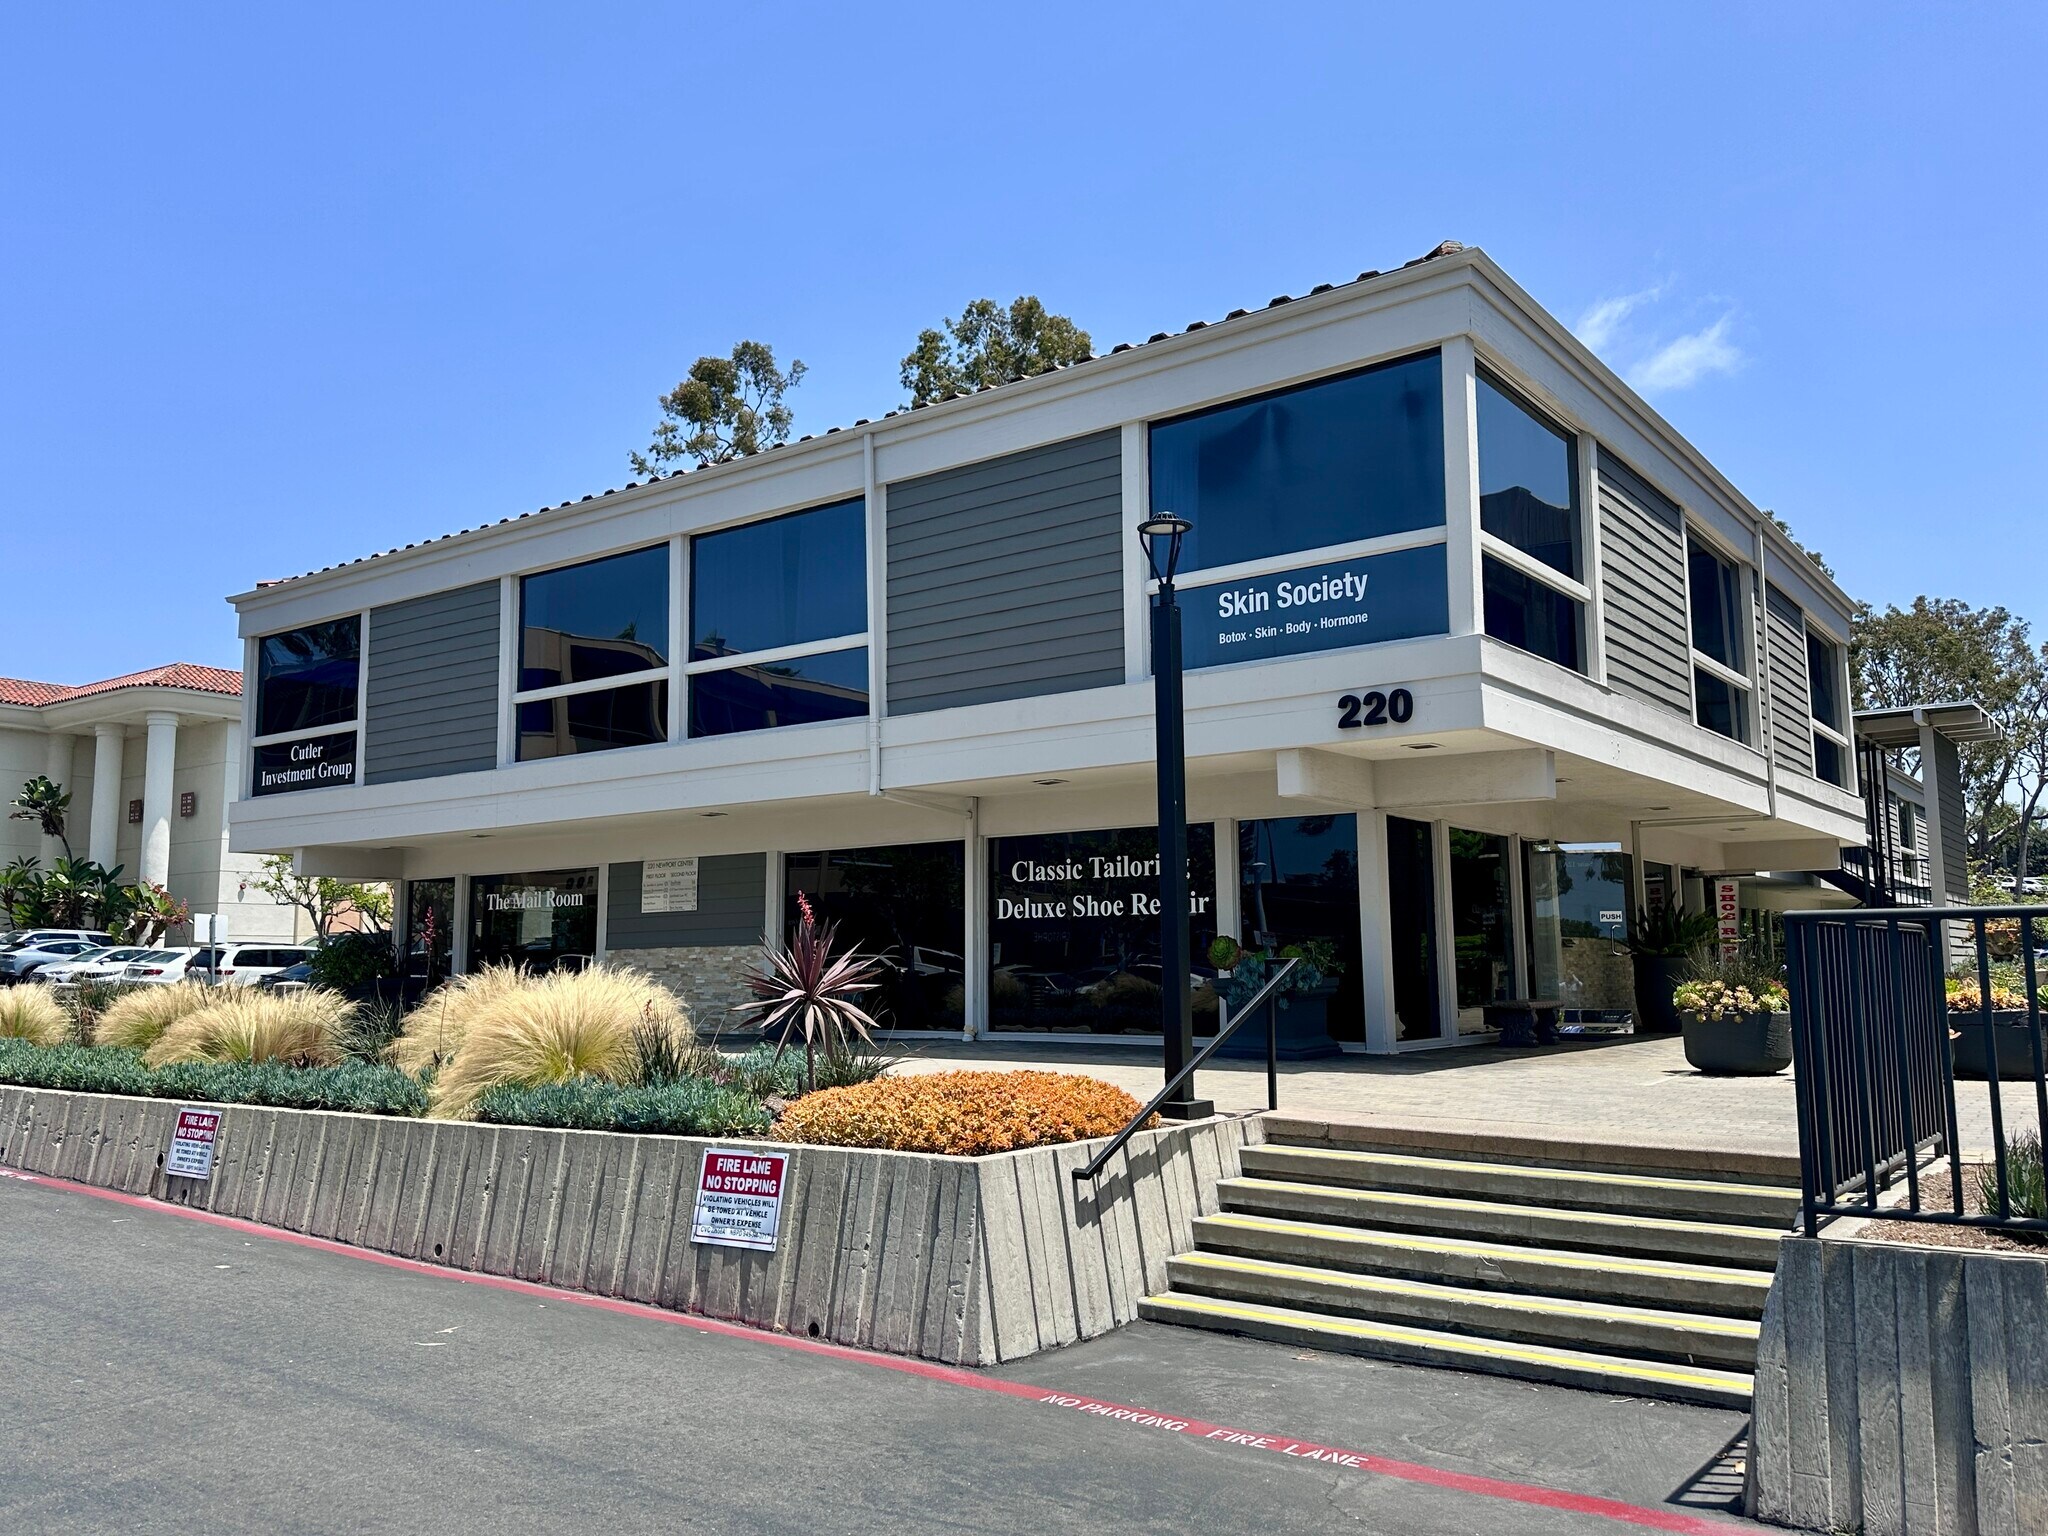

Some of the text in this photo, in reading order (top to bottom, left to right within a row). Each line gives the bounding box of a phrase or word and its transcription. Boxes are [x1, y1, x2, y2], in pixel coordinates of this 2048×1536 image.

[1218, 572, 1368, 618] Skin Society
[1219, 613, 1368, 644] Botox Skin Body Hormone
[1337, 688, 1414, 729] 220
[290, 743, 323, 761] Cutler
[261, 761, 353, 787] Investment Group
[1011, 853, 1191, 882] Classic Tailori
[486, 890, 584, 911] The Mail Room
[996, 891, 1210, 919] Deluxe Shoe Reir
[185, 1115, 198, 1125] FIRE
[177, 1127, 187, 1137] NO
[717, 1158, 772, 1175] FIRE LANE
[706, 1175, 777, 1194] NO STOPPING
[703, 1195, 775, 1208] VIOLATING VEHICLES WILL
[707, 1205, 716, 1213] BE
[716, 1206, 735, 1215] TOWED
[745, 1209, 768, 1219] VEHICLE
[710, 1216, 762, 1229] OWNER'S EXPENSE
[1040, 1393, 1370, 1468] NO PARKING FIRE LANE
